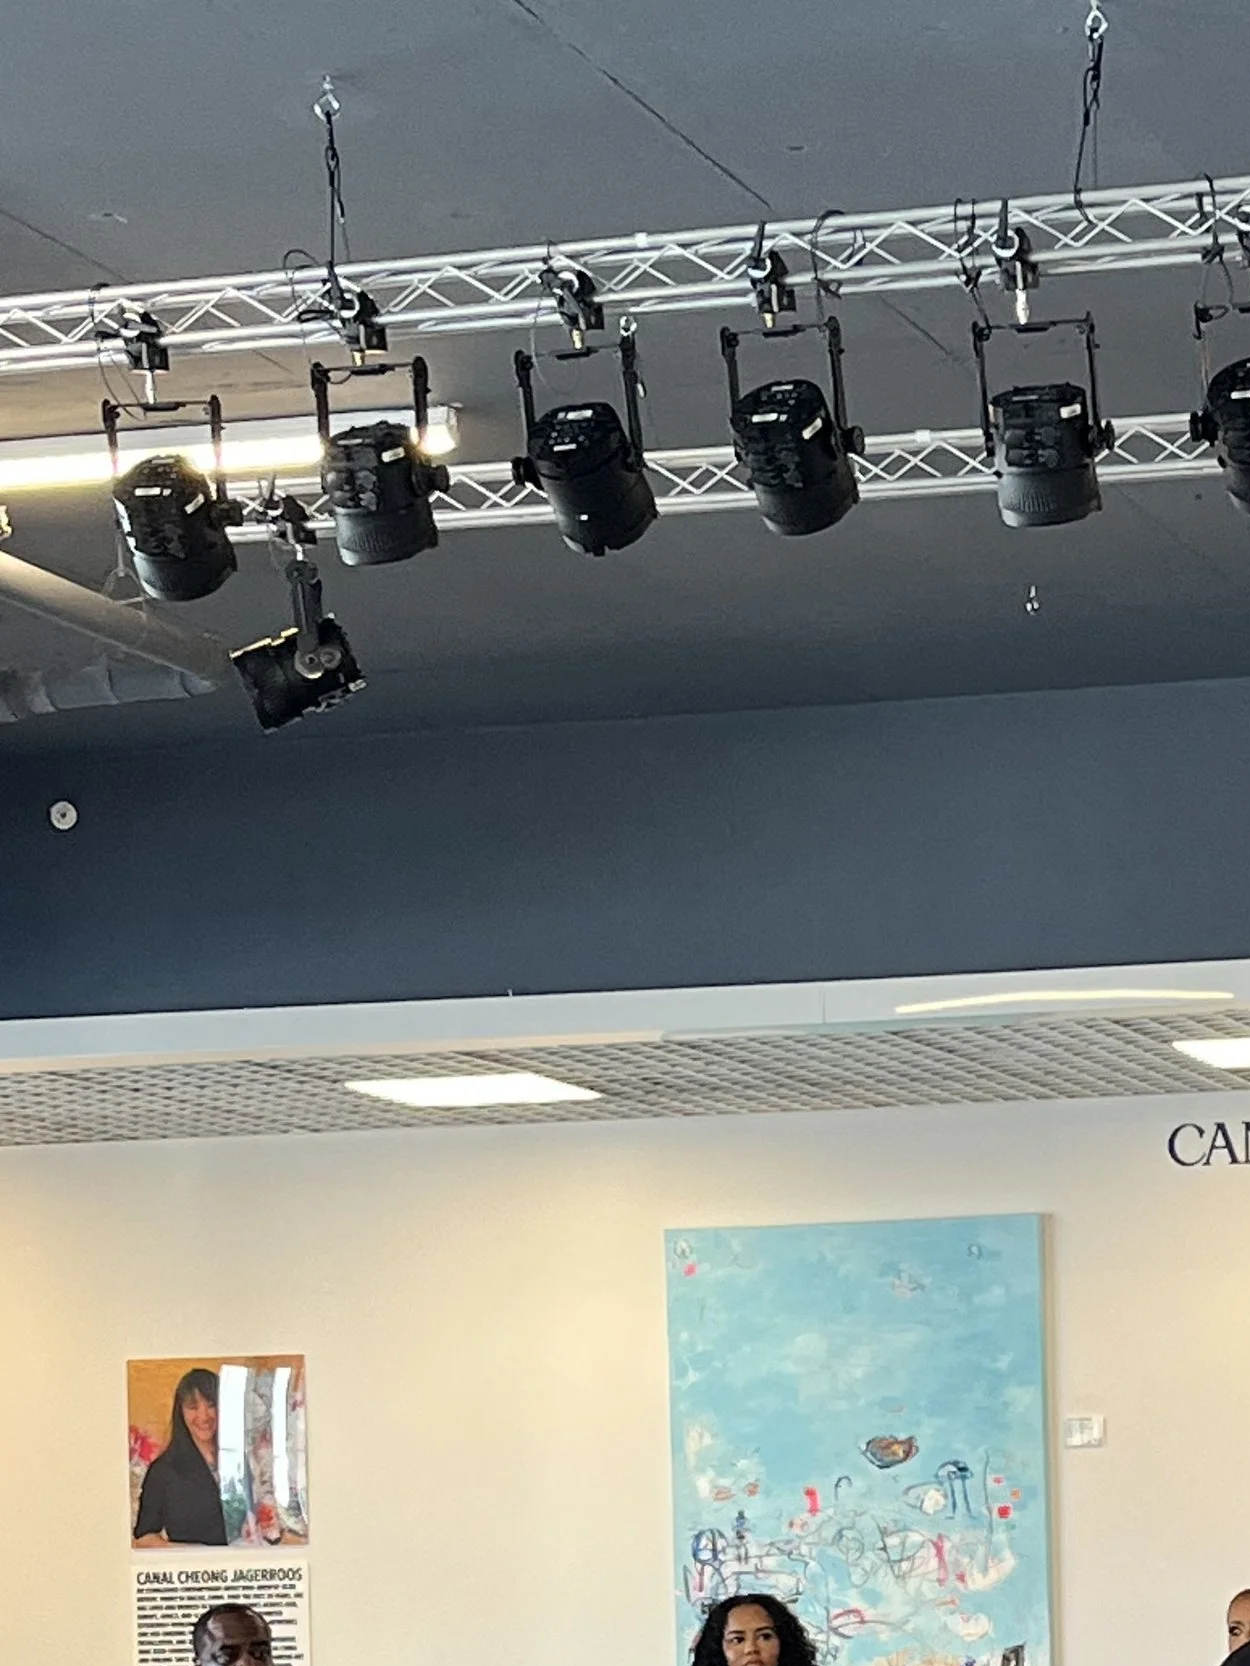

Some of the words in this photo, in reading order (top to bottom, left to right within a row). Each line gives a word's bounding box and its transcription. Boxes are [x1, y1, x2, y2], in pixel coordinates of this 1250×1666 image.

[136, 1571, 174, 1585] CANAL
[177, 1570, 229, 1584] CHEONG
[230, 1567, 303, 1582] JAGERROOS
